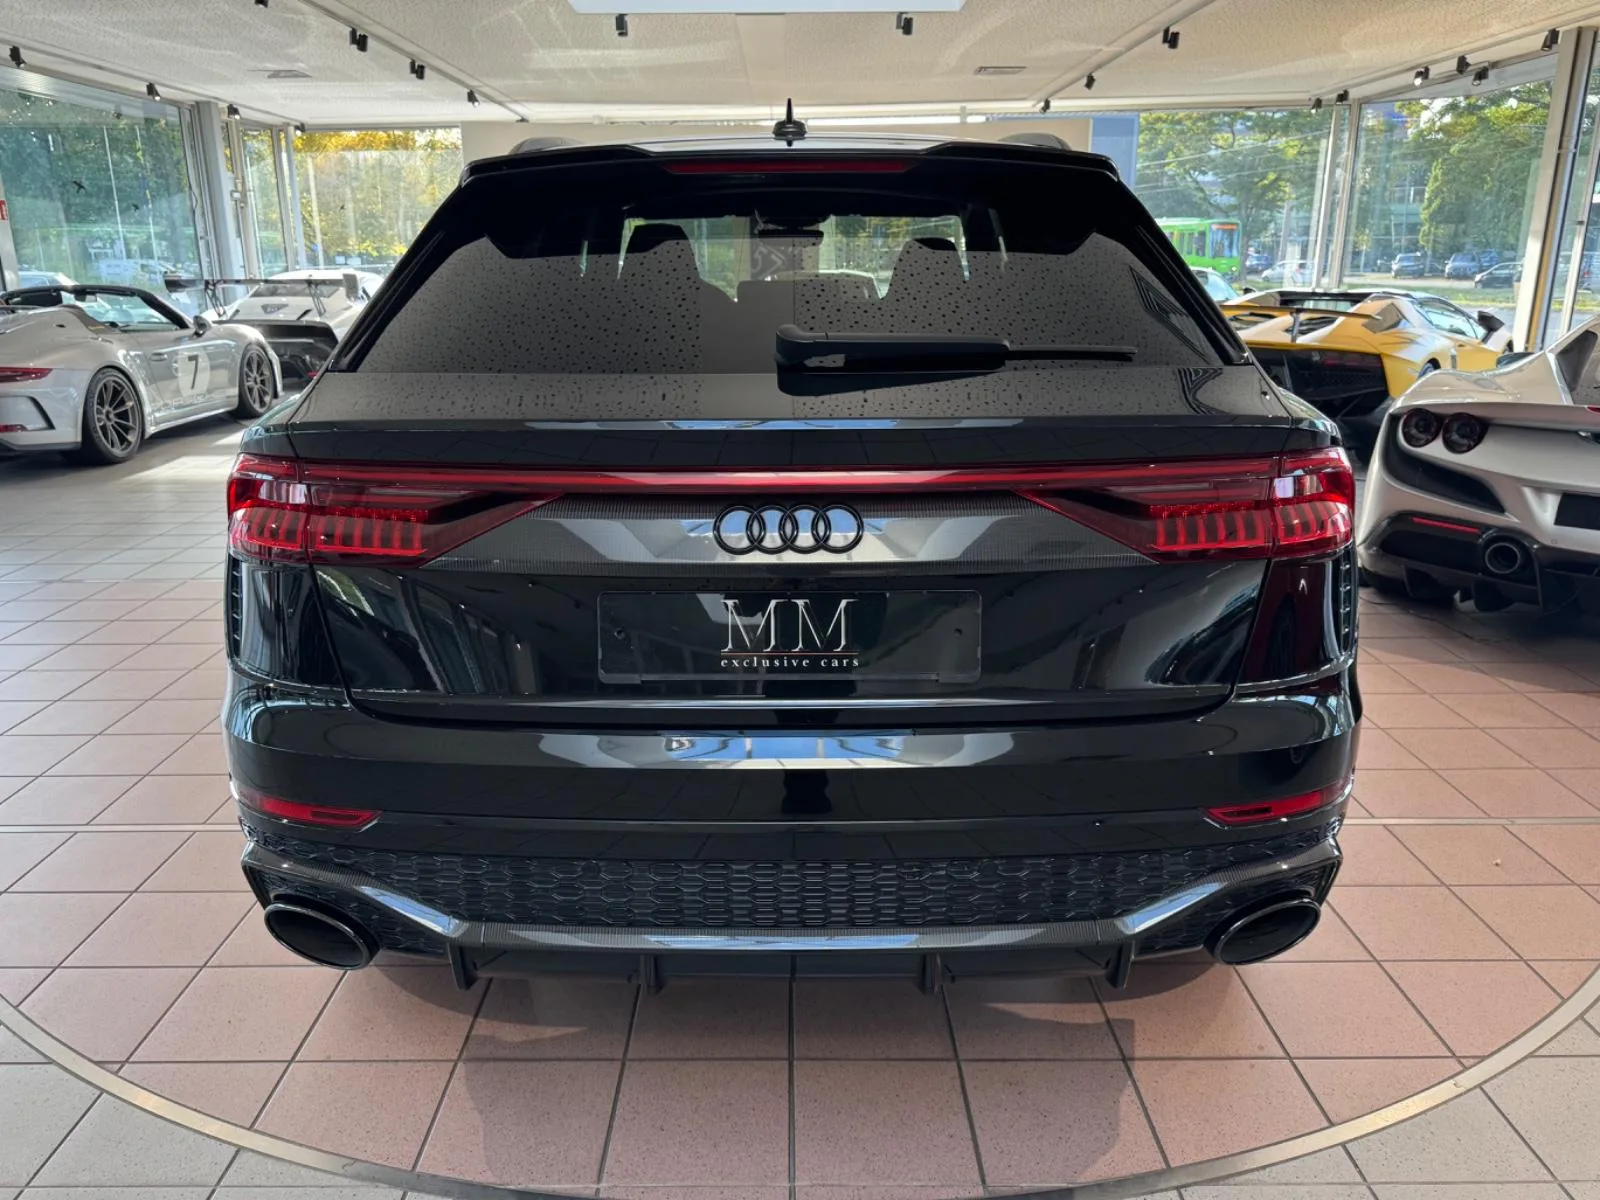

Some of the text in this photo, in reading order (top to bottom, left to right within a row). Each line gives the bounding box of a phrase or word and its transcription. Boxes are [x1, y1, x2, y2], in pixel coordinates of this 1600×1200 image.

[188, 354, 199, 389] 7
[721, 599, 859, 652] MM
[720, 656, 860, 667] exclusive cars
